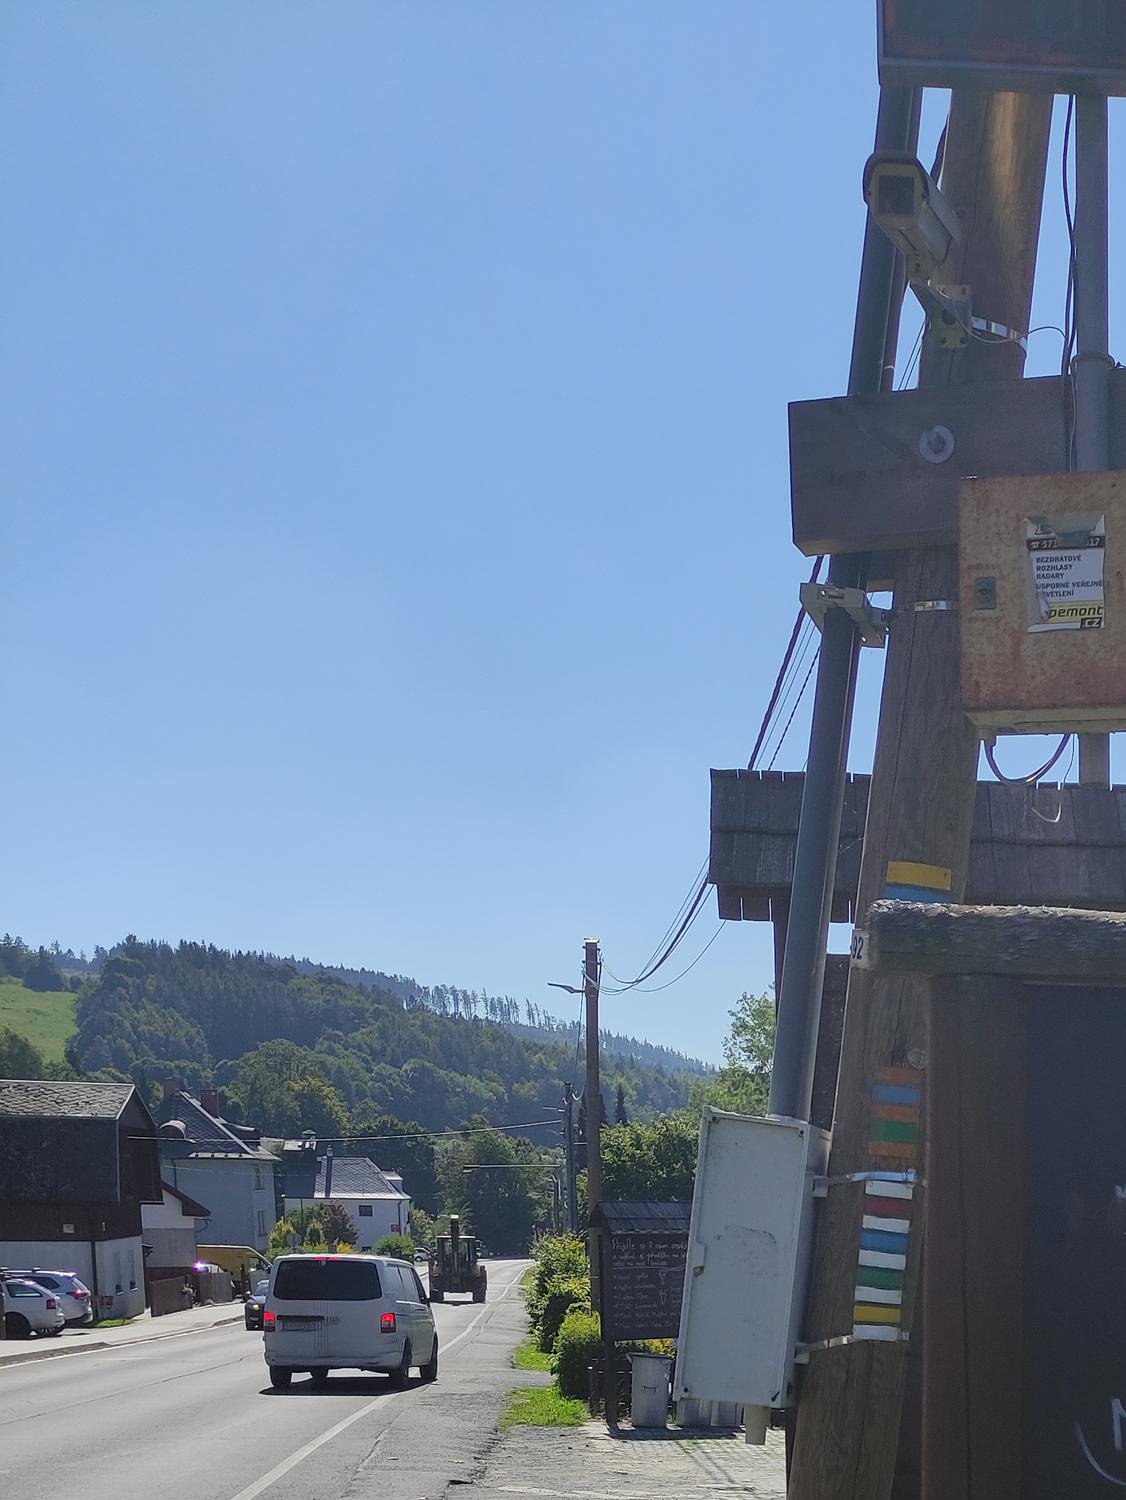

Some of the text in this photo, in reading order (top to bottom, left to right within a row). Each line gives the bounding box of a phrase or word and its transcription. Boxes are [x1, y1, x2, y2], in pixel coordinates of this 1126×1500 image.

[1036, 564, 1074, 572] ROZHLASY
[1046, 589, 1075, 598] VĚTLENÍ
[1049, 605, 1105, 619] pemont
